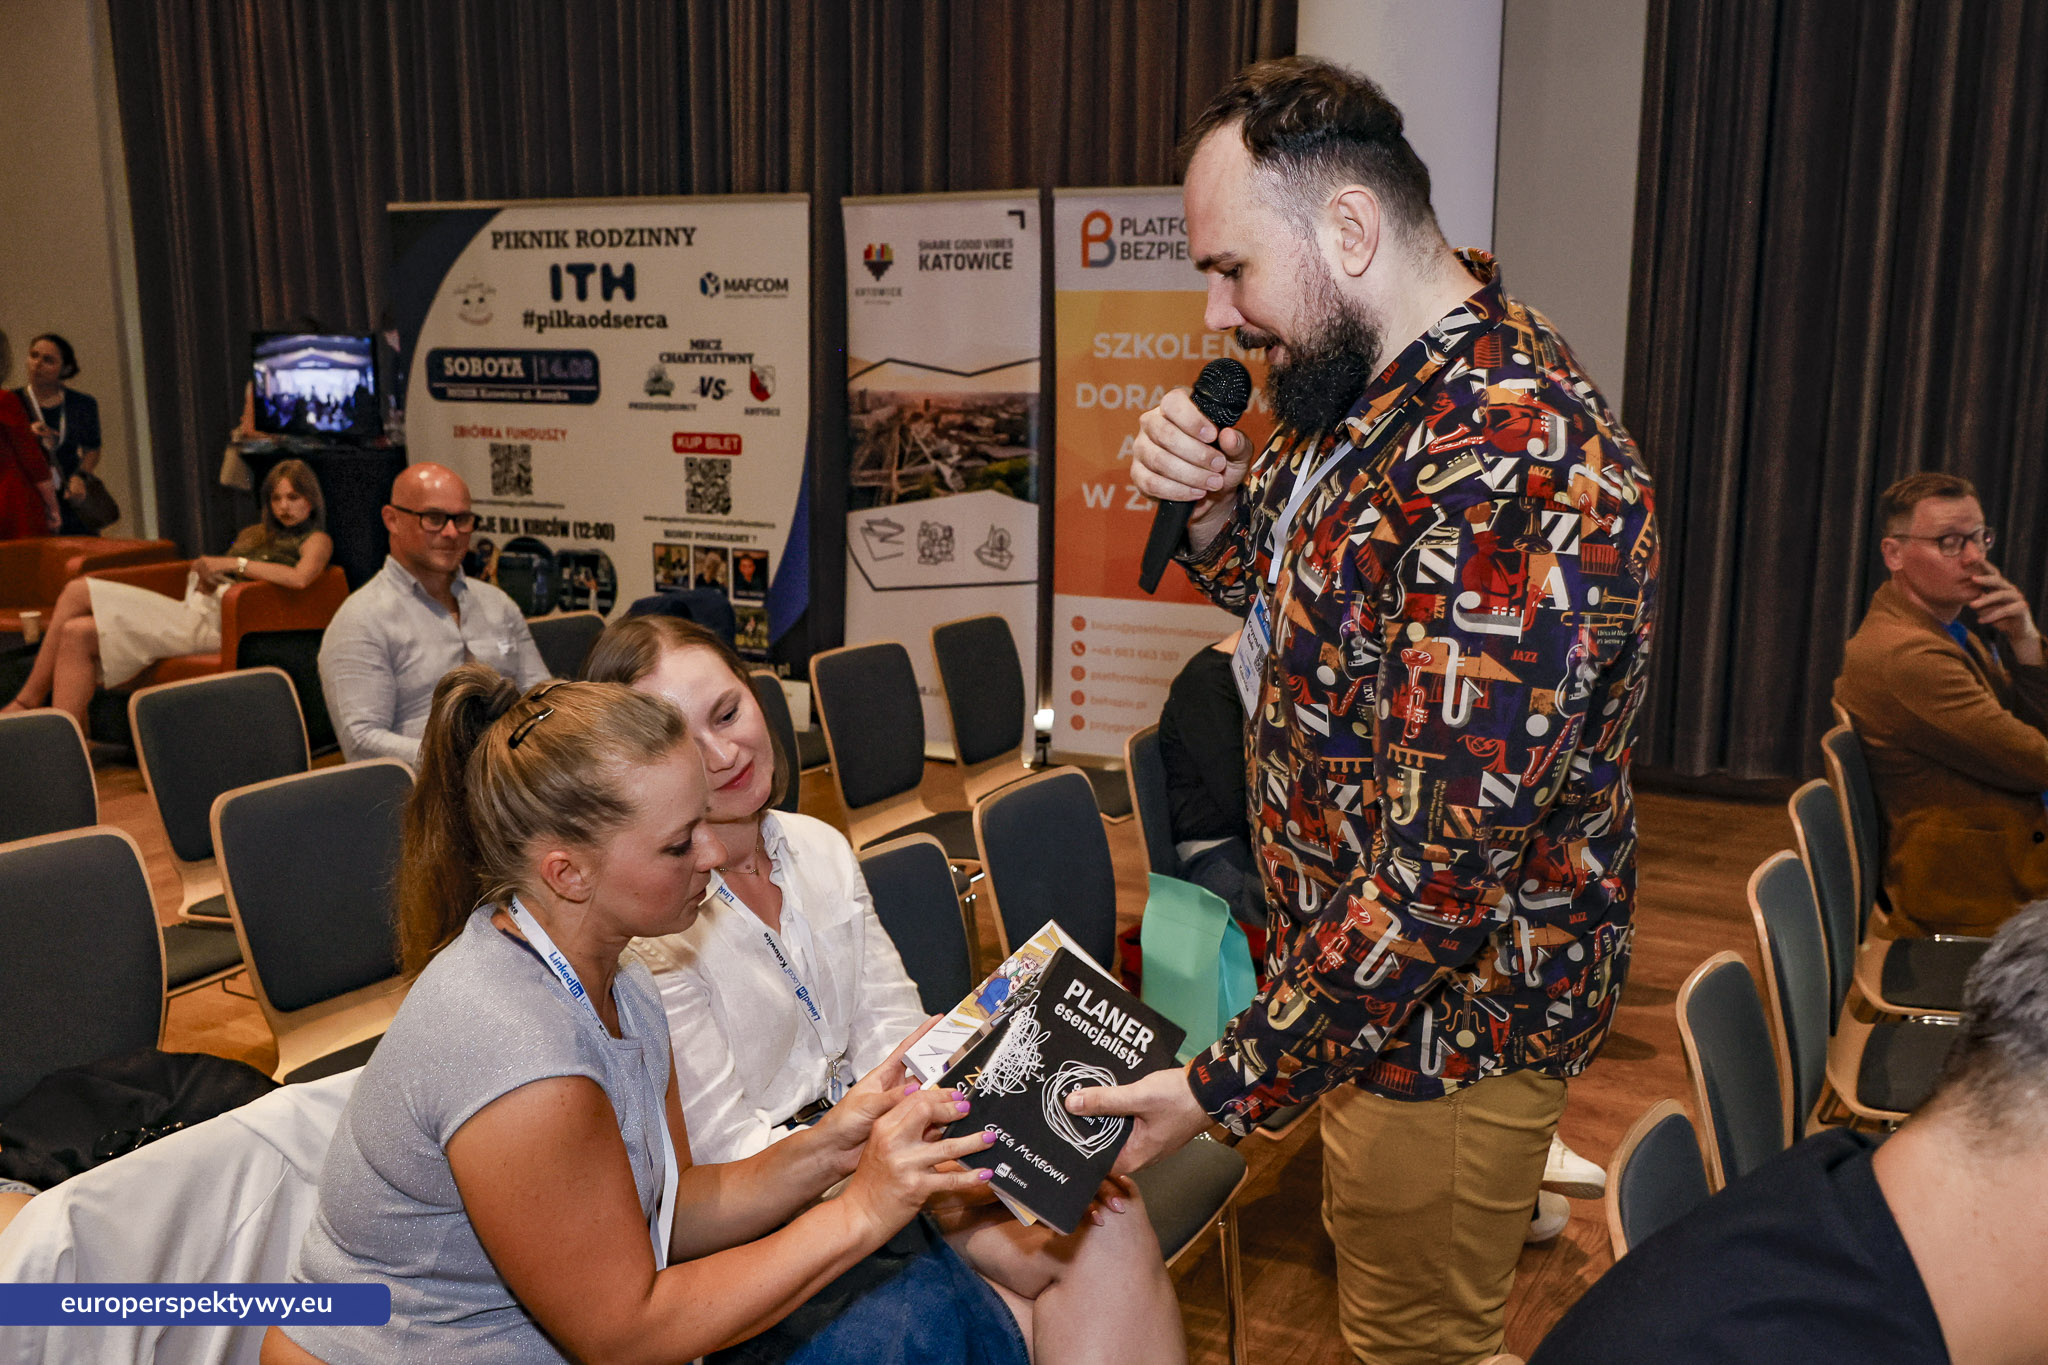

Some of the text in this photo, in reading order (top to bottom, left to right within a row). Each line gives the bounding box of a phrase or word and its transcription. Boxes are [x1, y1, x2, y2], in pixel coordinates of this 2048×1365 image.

[491, 227, 696, 250] PIKNIK RODZINNY
[919, 239, 951, 250] SHARE
[954, 239, 982, 250] GOOD
[1121, 241, 1190, 260] BEZPIE
[919, 252, 1014, 271] KATOWICE
[551, 262, 636, 302] ITH
[724, 278, 789, 292] MAFCOM
[443, 357, 526, 378] SOBOTA
[700, 376, 726, 401] VS
[677, 437, 702, 449] KUP
[1529, 465, 1554, 478] JAZZ
[1082, 484, 1116, 509] W
[1511, 650, 1538, 663] JAZZ
[763, 932, 788, 969] Katowice
[1063, 979, 1155, 1053] PLANER
[1054, 1003, 1143, 1070] esencjalisty
[984, 1123, 1016, 1149] GREG
[1008, 1171, 1029, 1189] biznes
